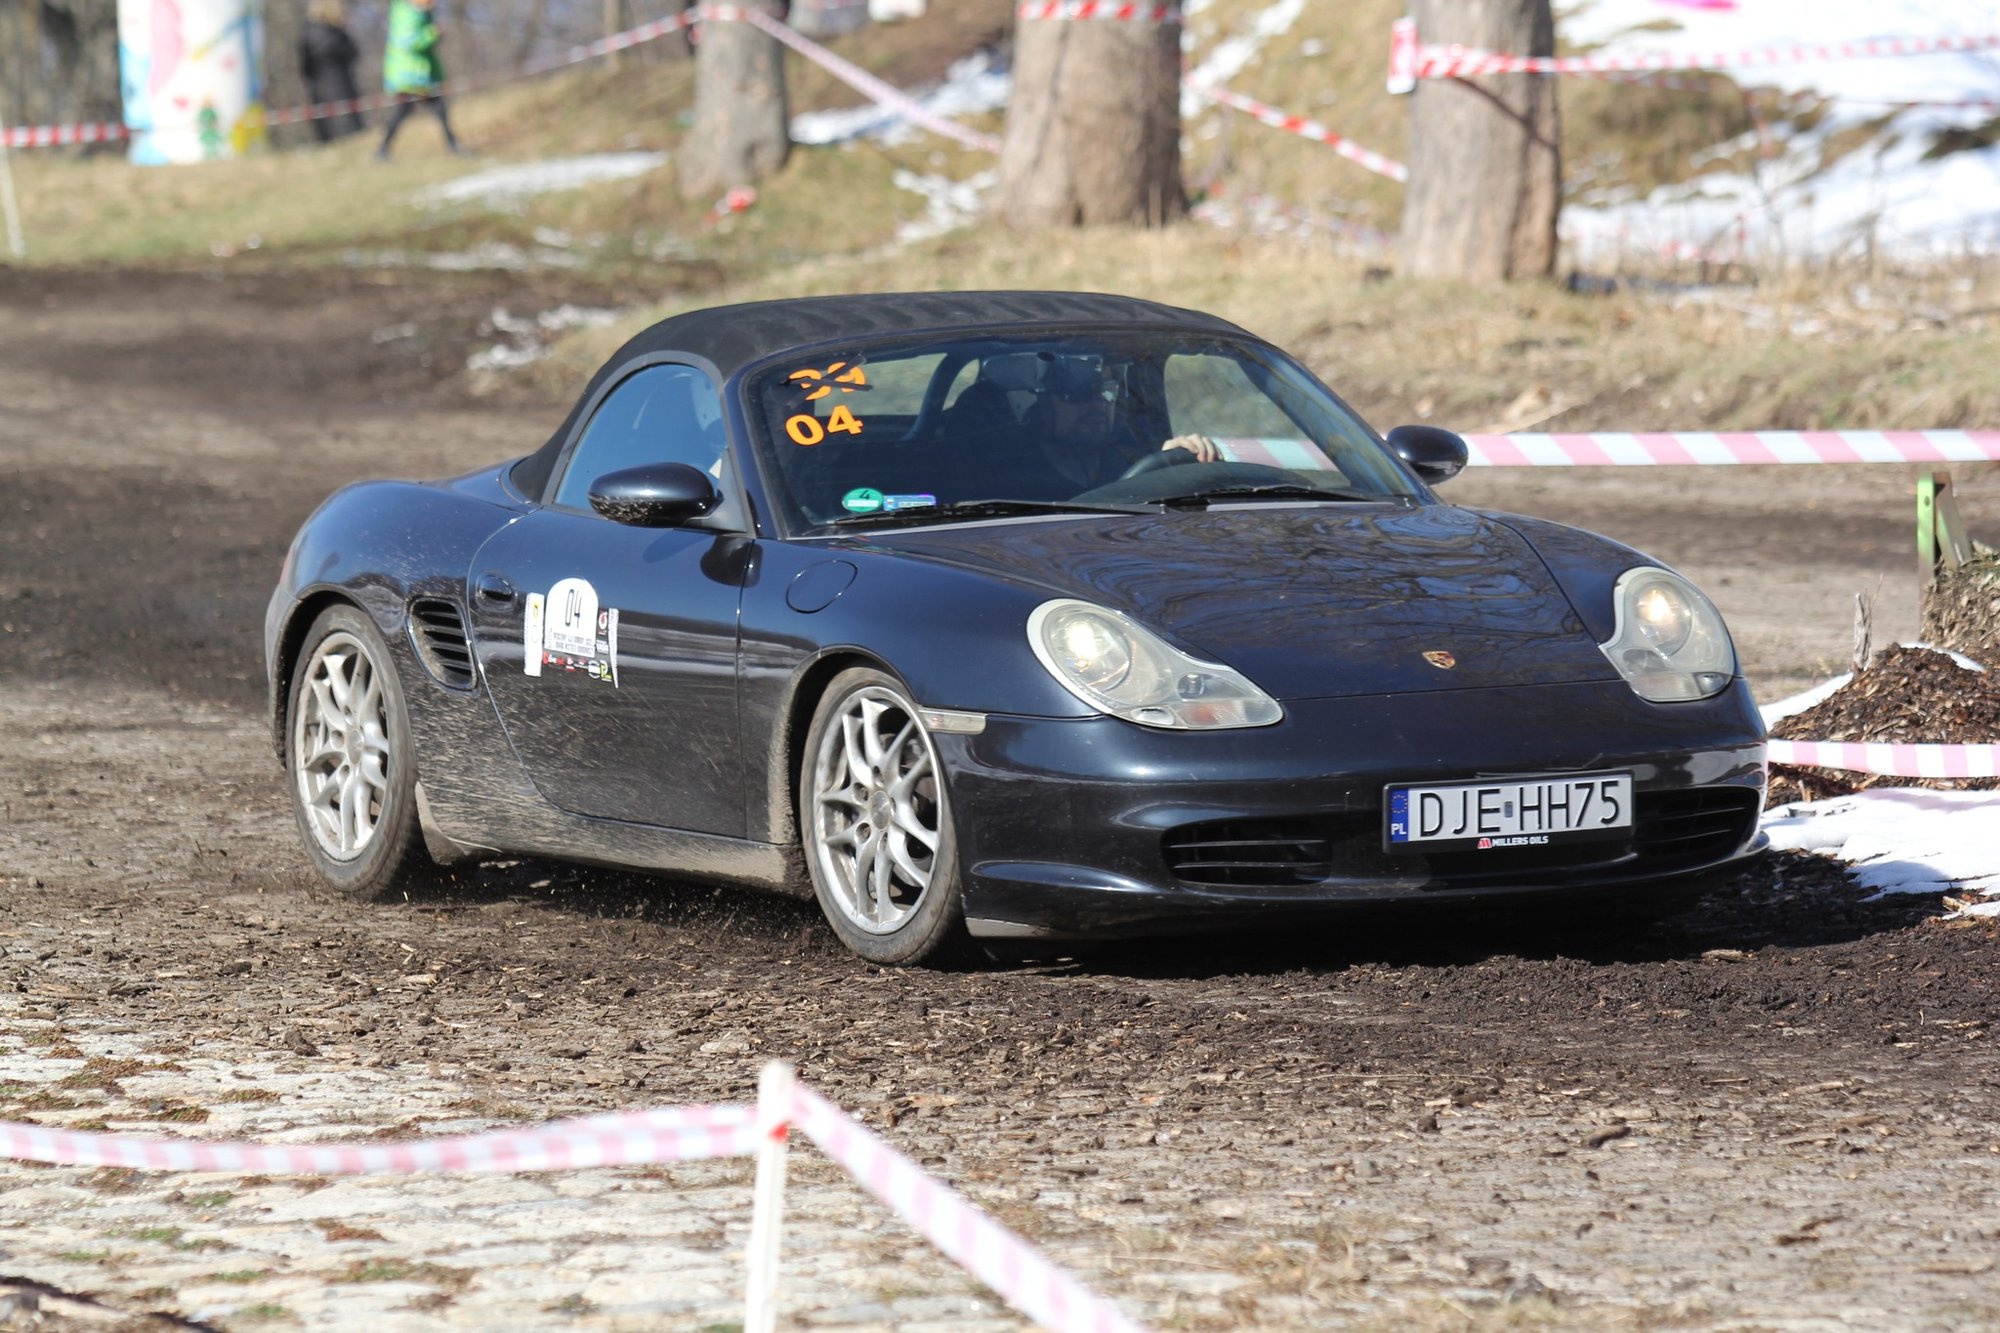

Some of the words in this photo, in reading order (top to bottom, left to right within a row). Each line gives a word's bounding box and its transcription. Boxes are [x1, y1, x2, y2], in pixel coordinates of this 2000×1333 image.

[785, 404, 864, 446] 04
[859, 489, 871, 500] 4
[564, 588, 583, 629] 04
[1419, 788, 1501, 838] DJE
[1519, 780, 1620, 832] HH75
[1390, 822, 1408, 836] PL
[1491, 836, 1529, 847] MILLERS
[1529, 835, 1550, 845] OILS
